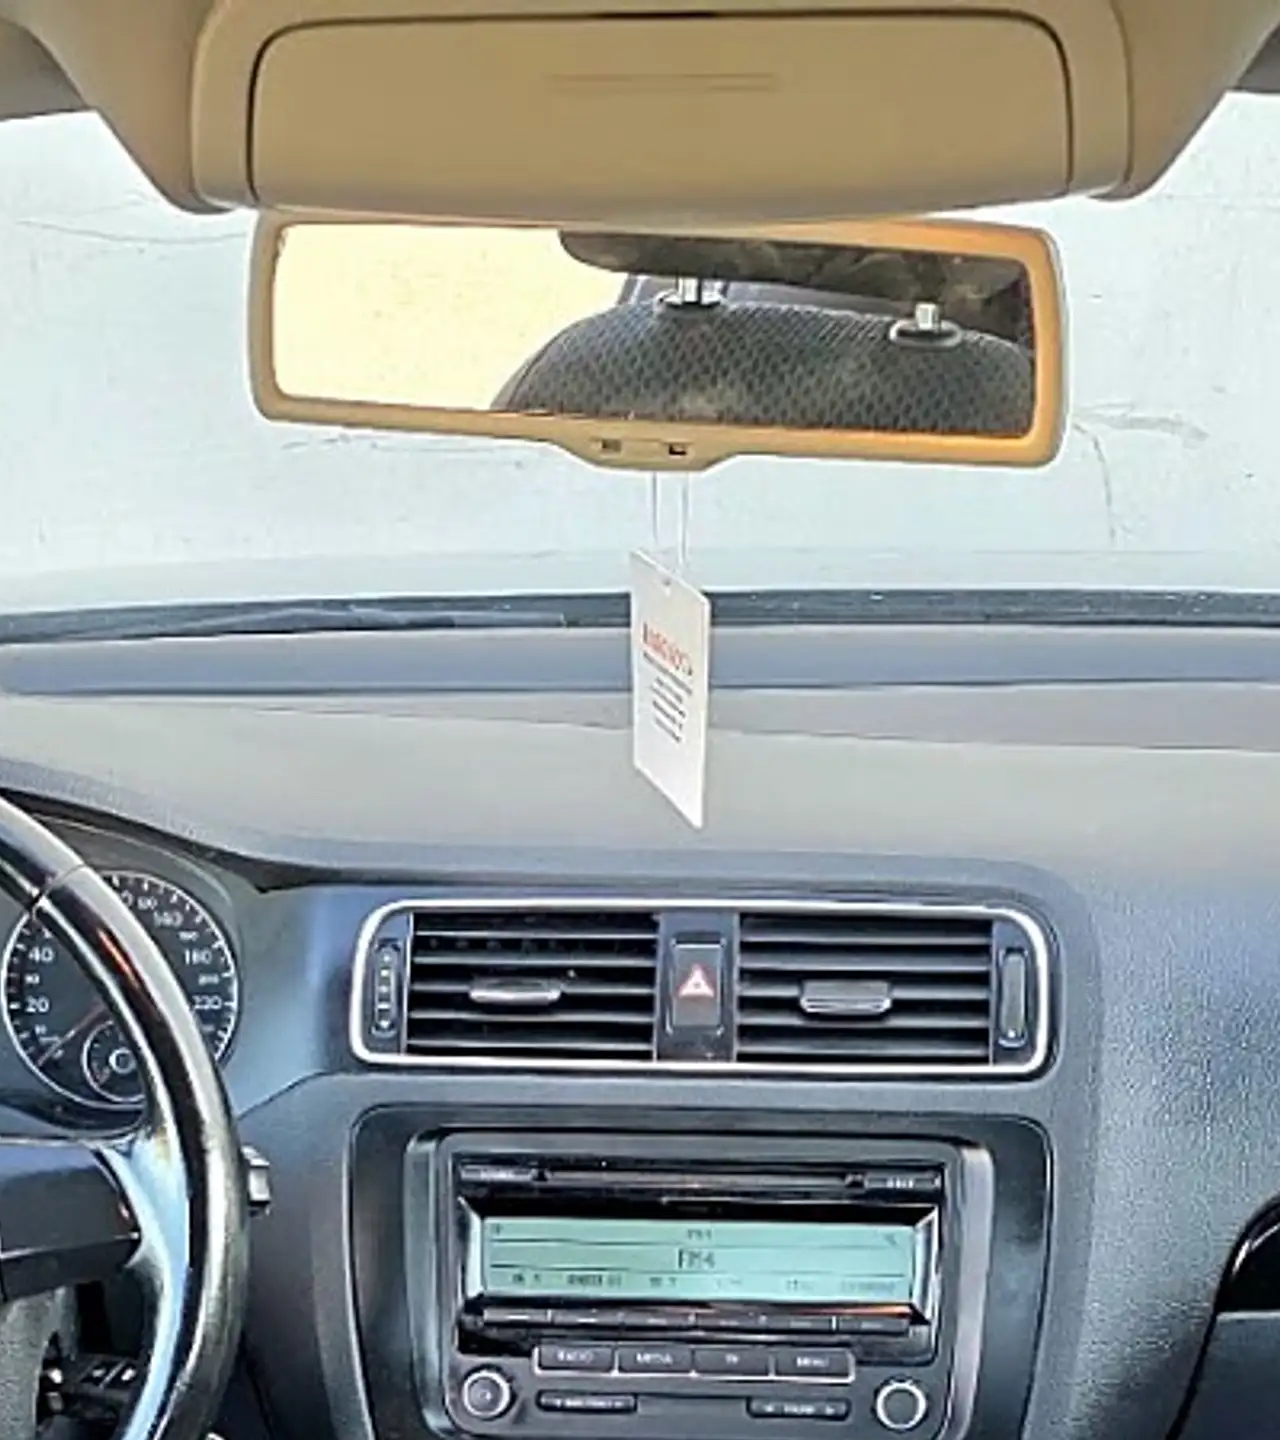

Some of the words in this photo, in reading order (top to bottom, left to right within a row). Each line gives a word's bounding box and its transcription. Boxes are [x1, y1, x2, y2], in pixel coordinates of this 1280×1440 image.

[28, 948, 55, 963] 40
[24, 996, 50, 1013] 20
[192, 995, 222, 1010] 220
